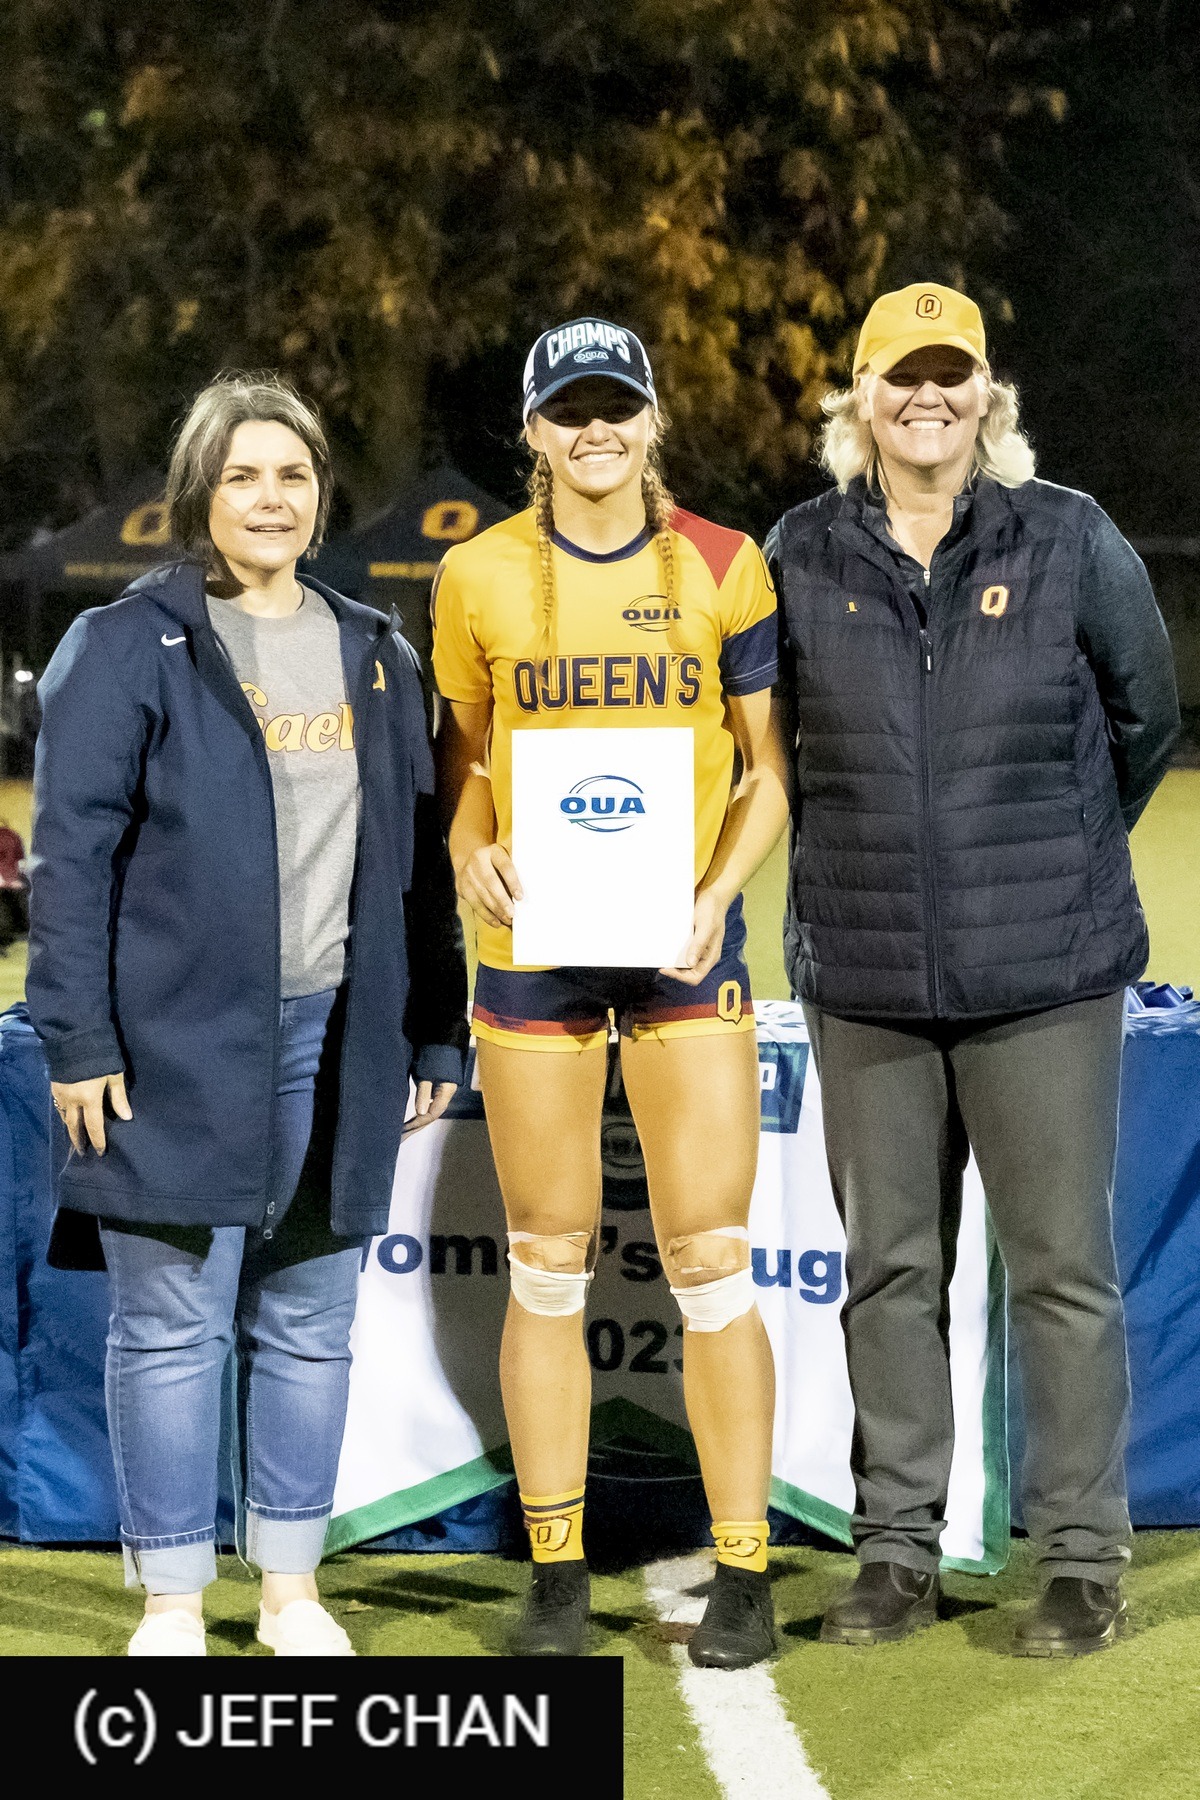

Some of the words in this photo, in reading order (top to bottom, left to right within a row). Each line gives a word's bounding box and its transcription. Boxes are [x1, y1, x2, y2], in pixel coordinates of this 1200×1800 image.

[916, 294, 942, 320] Q
[547, 322, 631, 369] CHAMPS
[622, 608, 682, 621] OUA
[980, 585, 1009, 618] Q
[513, 653, 703, 714] QUEEN'S
[559, 796, 646, 814] OUA
[716, 979, 743, 1025] Q
